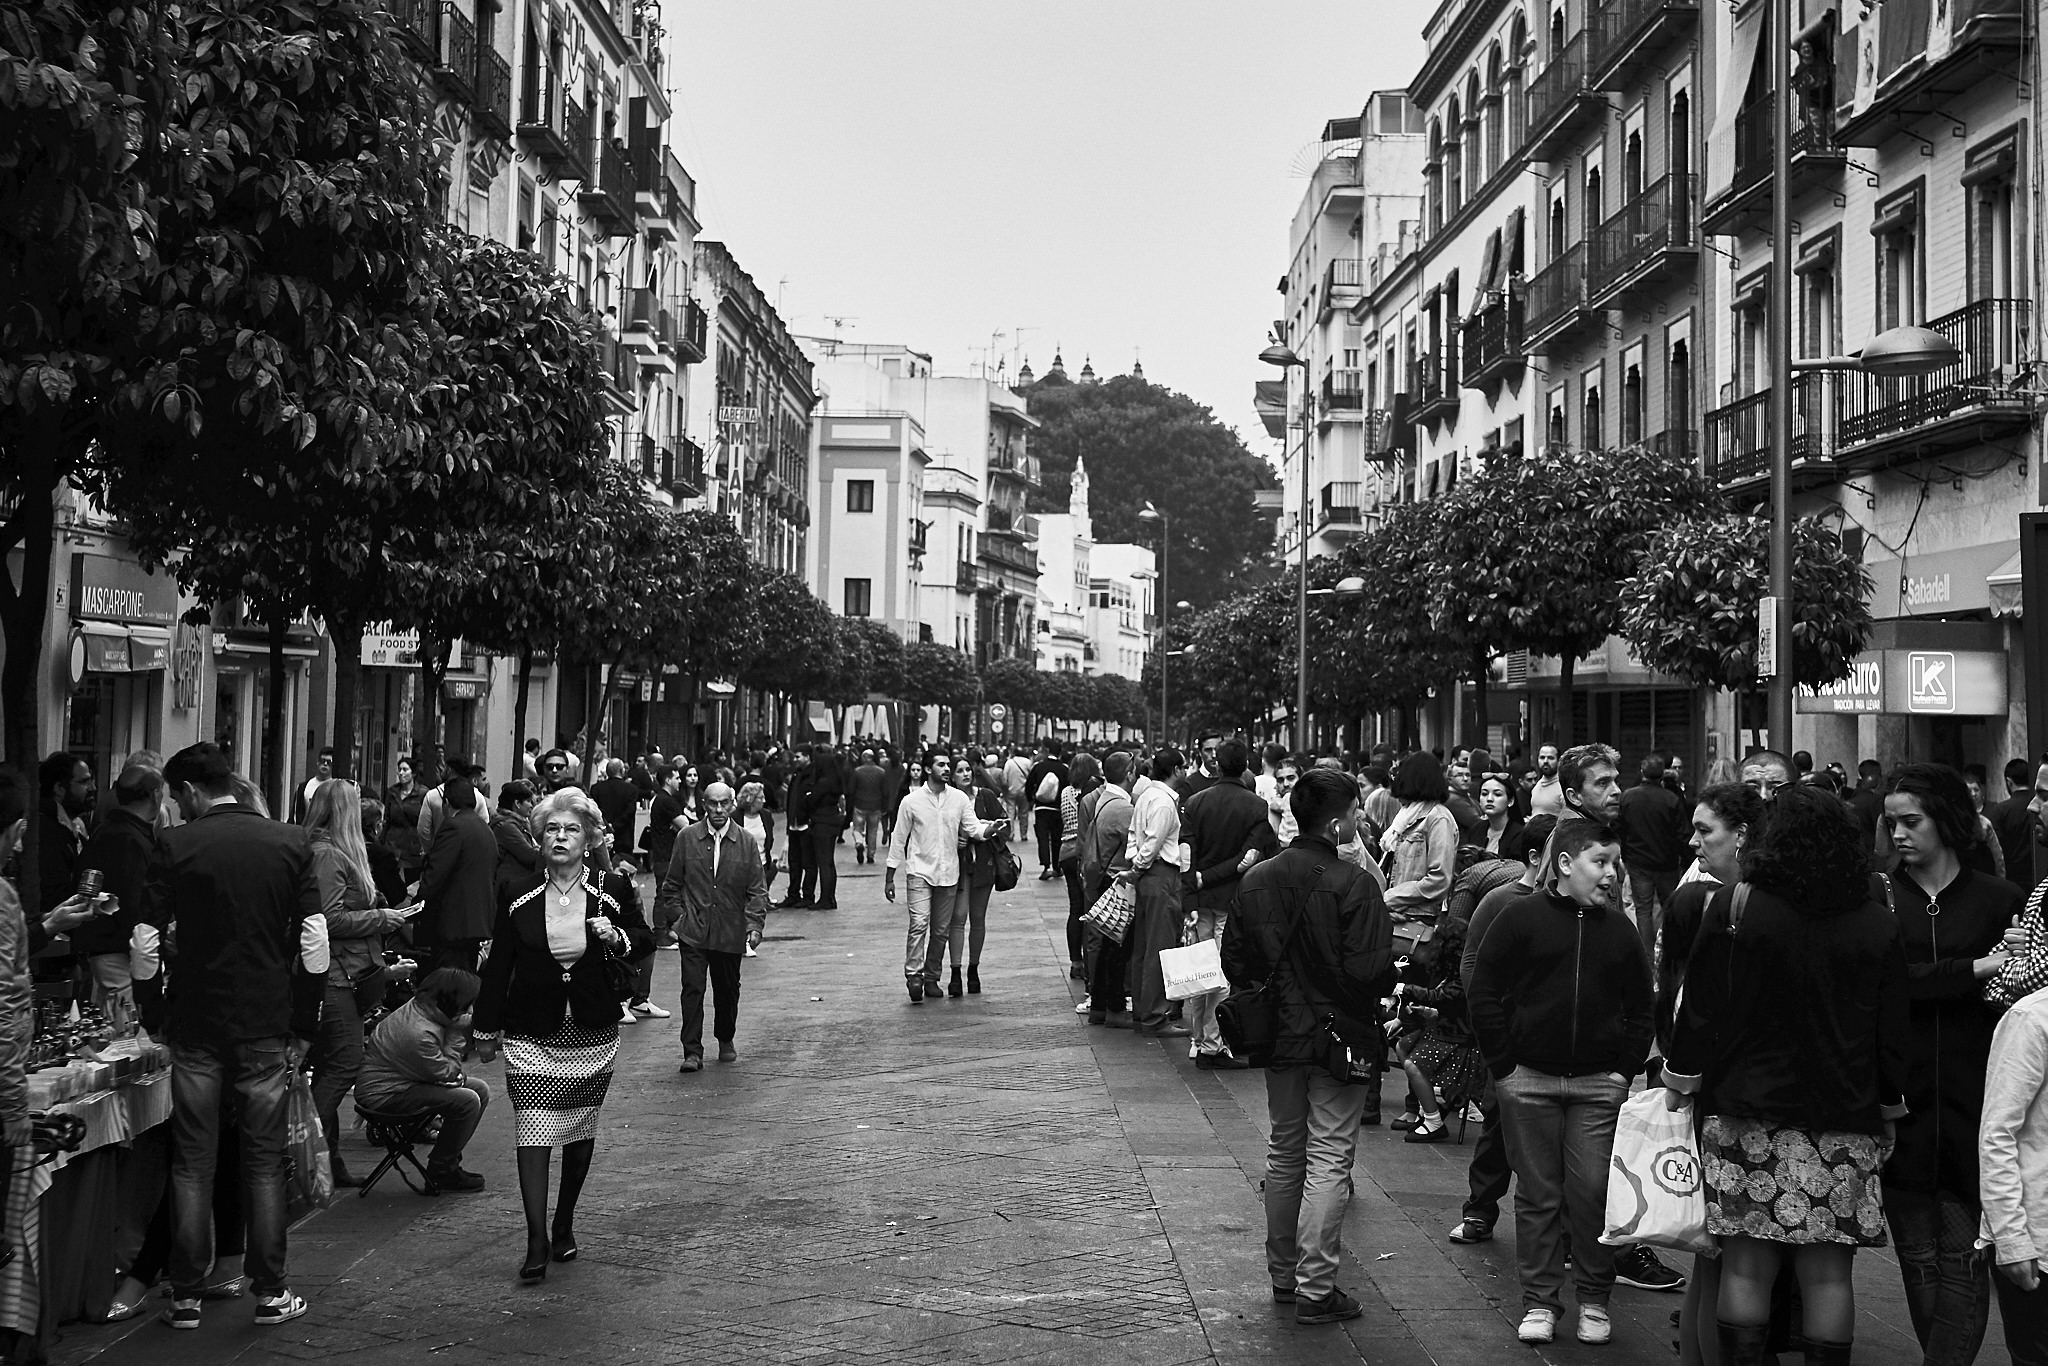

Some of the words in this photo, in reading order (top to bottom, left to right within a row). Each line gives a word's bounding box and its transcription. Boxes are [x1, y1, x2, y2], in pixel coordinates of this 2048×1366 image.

[721, 408, 756, 421] TABERNA
[728, 424, 745, 521] MIAM
[82, 586, 143, 617] MASCARPONE
[1907, 573, 1950, 605] Sabadell
[380, 639, 406, 649] FOOD
[1194, 971, 1217, 981] Hierro
[1662, 1159, 1694, 1185] C&A
